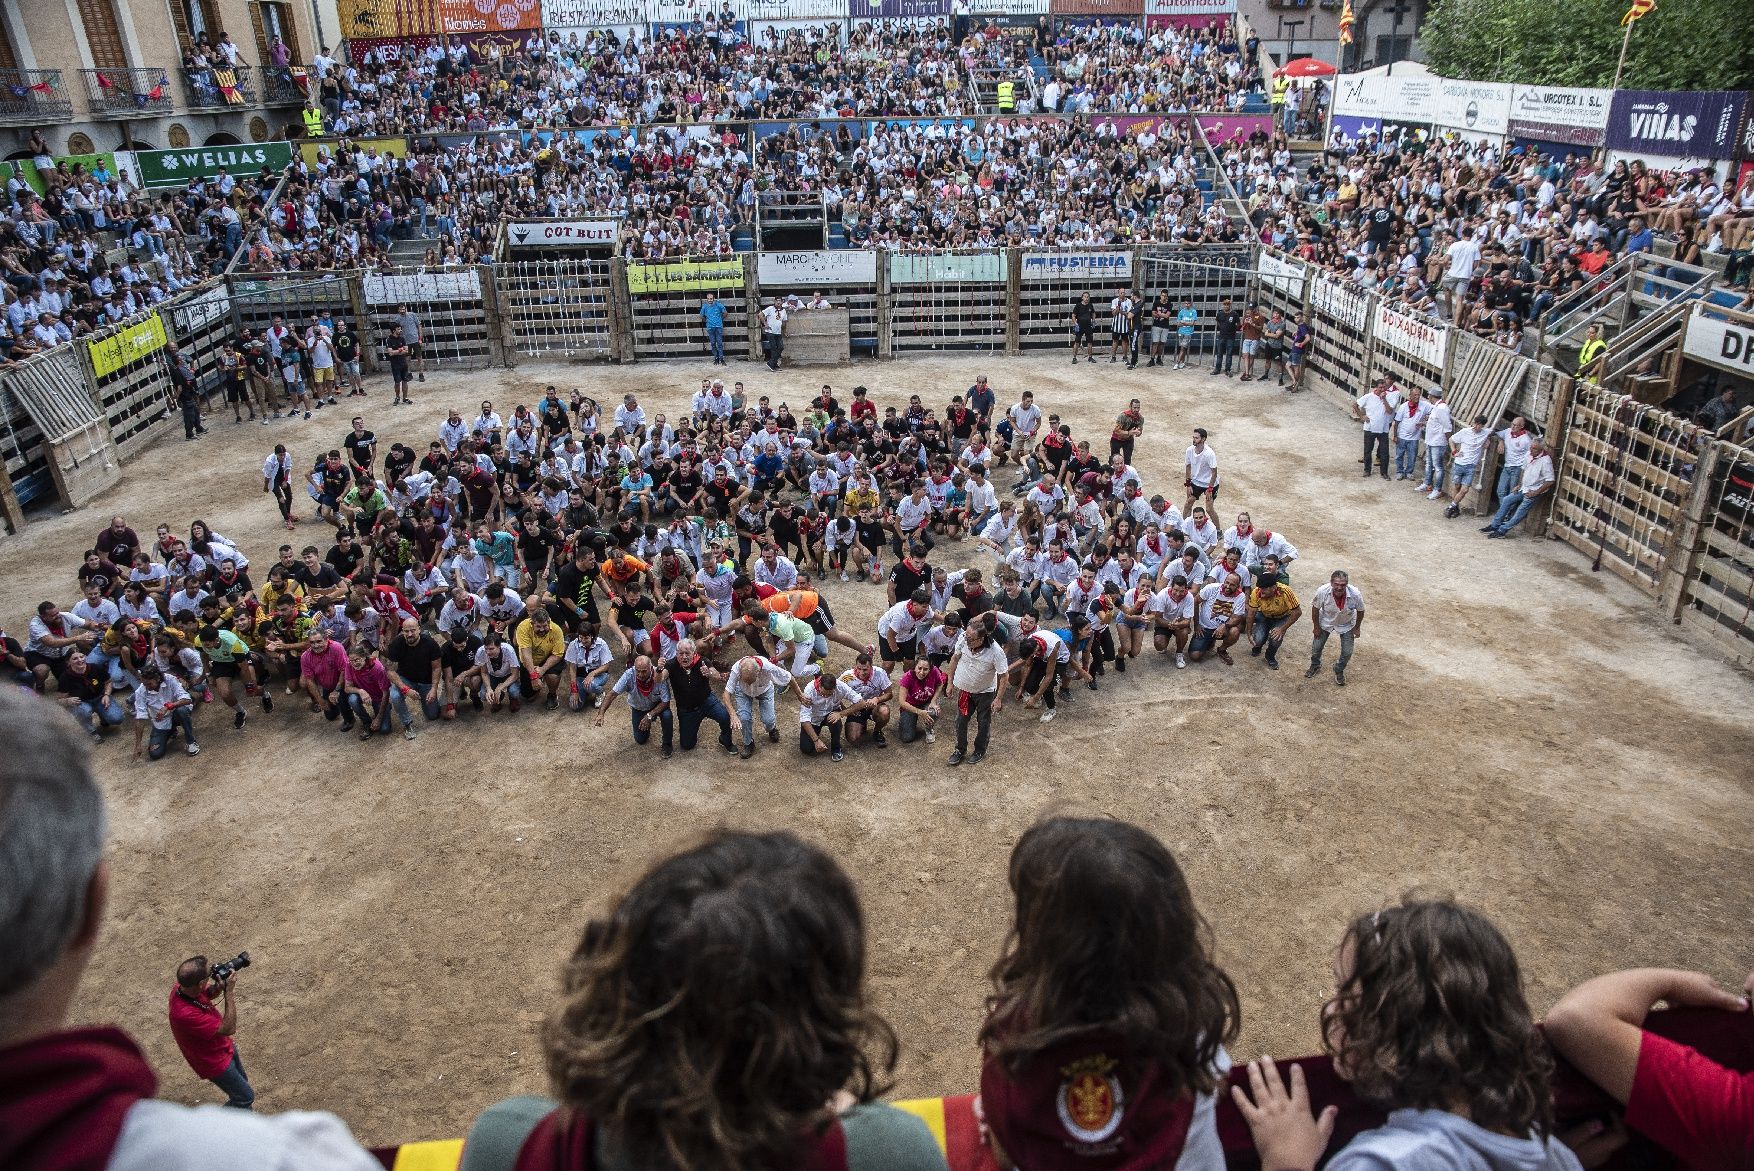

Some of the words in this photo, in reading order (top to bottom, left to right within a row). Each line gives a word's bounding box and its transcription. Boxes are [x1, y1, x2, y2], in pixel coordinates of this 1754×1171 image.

[548, 7, 641, 25] RESTAURANT
[1543, 92, 1577, 106] URCOTEX
[180, 149, 267, 168] WELIAS
[544, 226, 573, 239] GOT
[576, 228, 613, 239] BUIT
